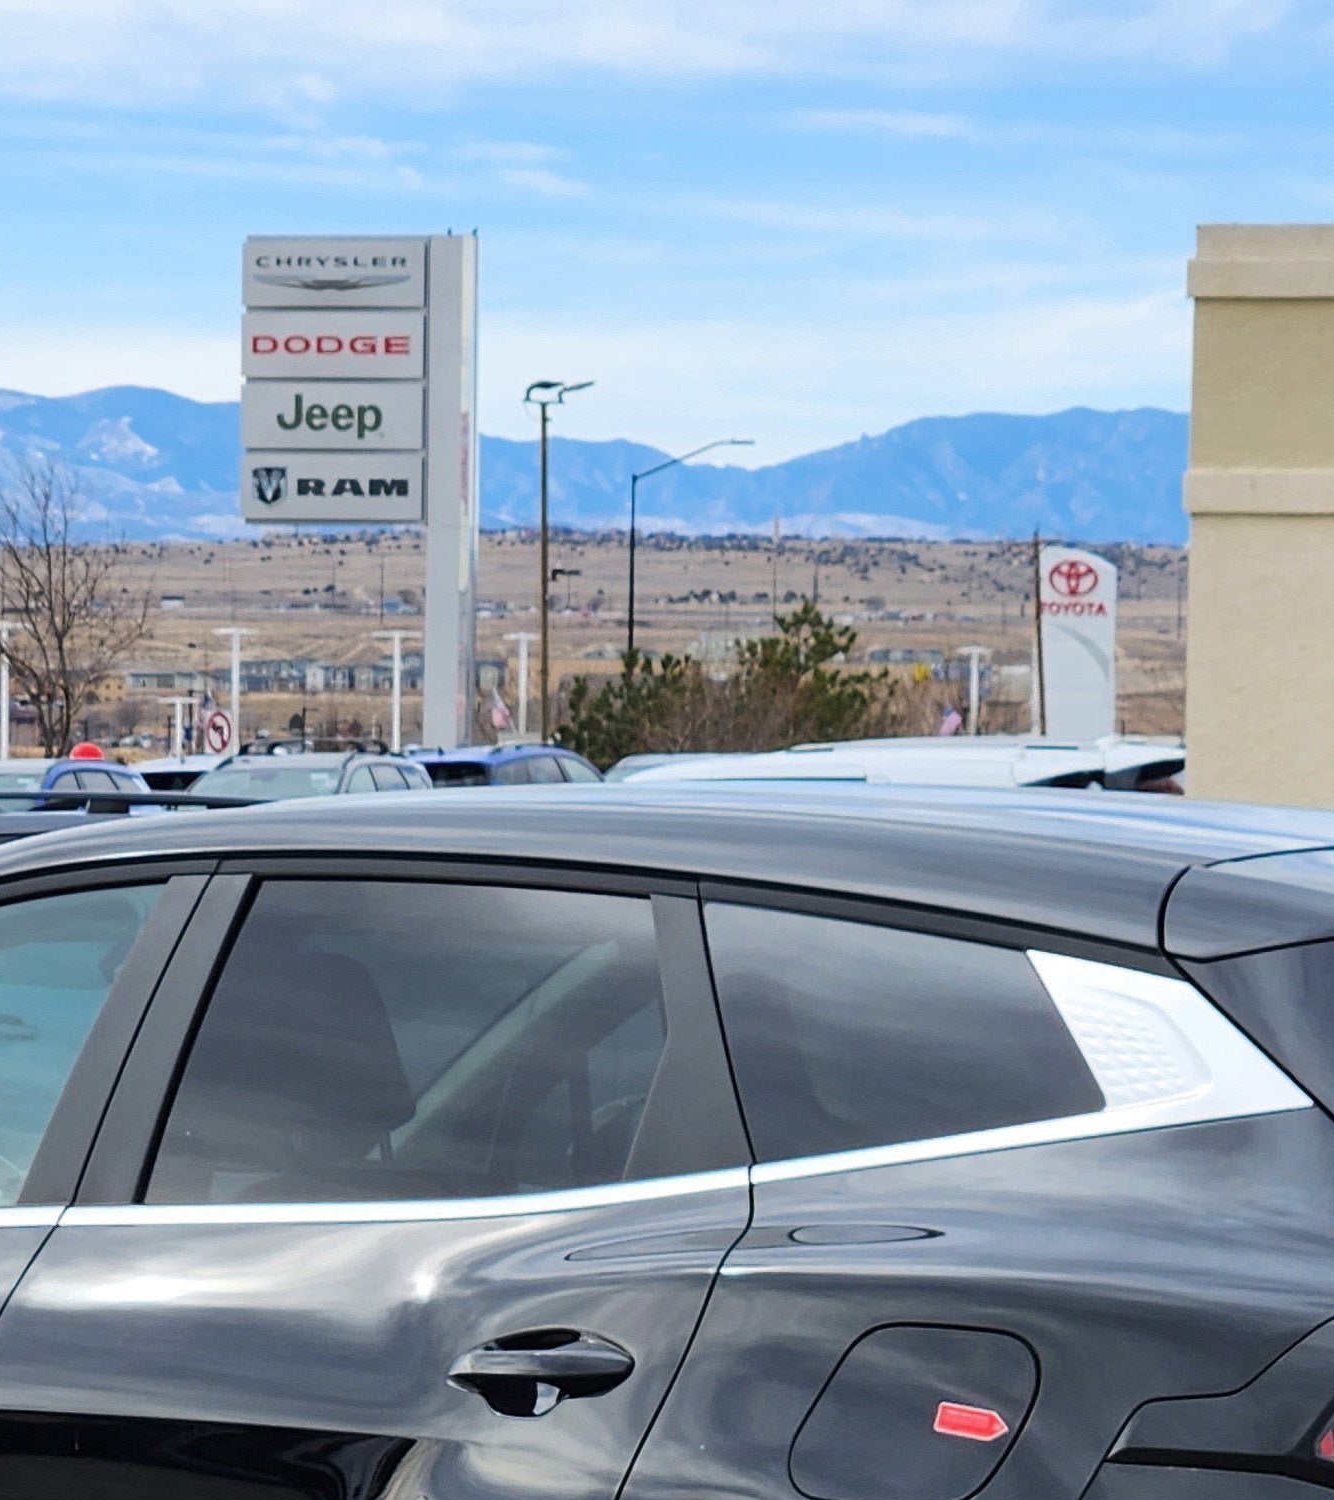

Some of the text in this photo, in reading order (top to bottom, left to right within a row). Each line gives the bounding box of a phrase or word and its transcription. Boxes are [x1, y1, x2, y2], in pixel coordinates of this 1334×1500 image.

[255, 255, 407, 269] CHRYSLER
[251, 335, 411, 356] DODGE
[276, 393, 382, 440] Jeep
[296, 478, 409, 497] RAM
